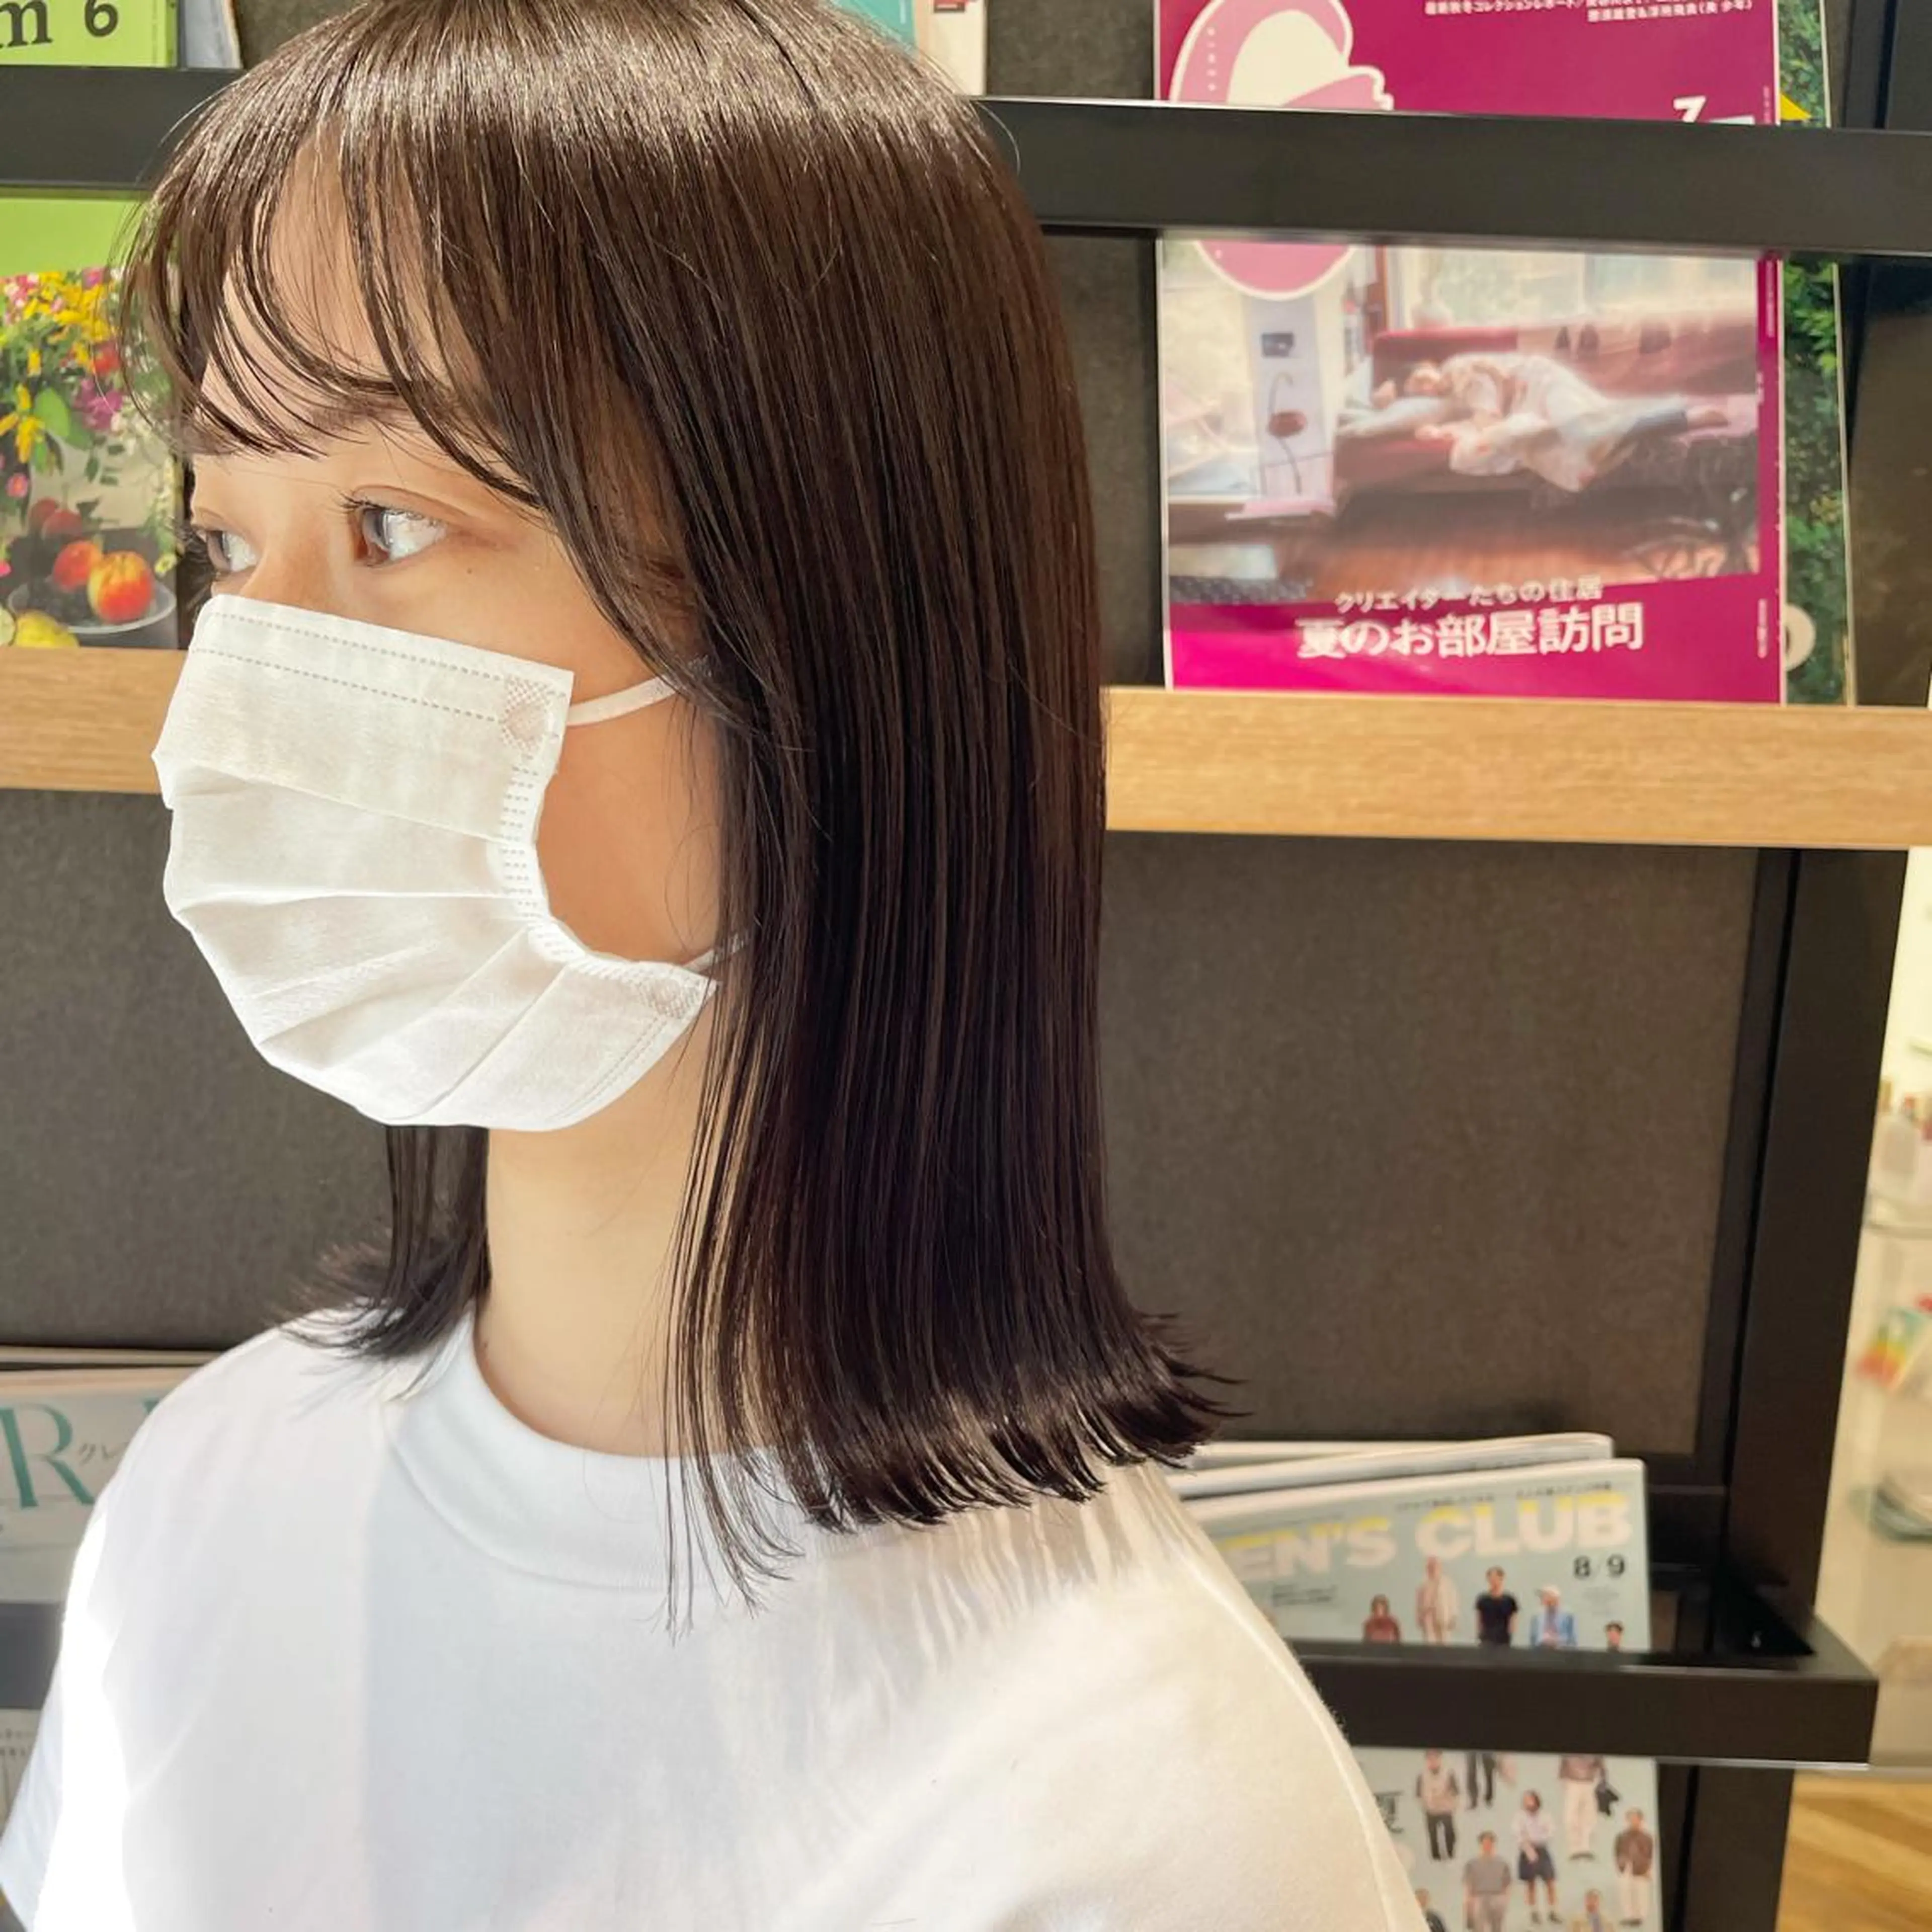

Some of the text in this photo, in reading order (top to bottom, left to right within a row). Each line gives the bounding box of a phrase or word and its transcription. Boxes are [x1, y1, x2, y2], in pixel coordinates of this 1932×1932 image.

[84, 0, 118, 37] 6
[1295, 602, 1644, 659] 夏のお部屋訪問
[1415, 1489, 1633, 1559] CLUB
